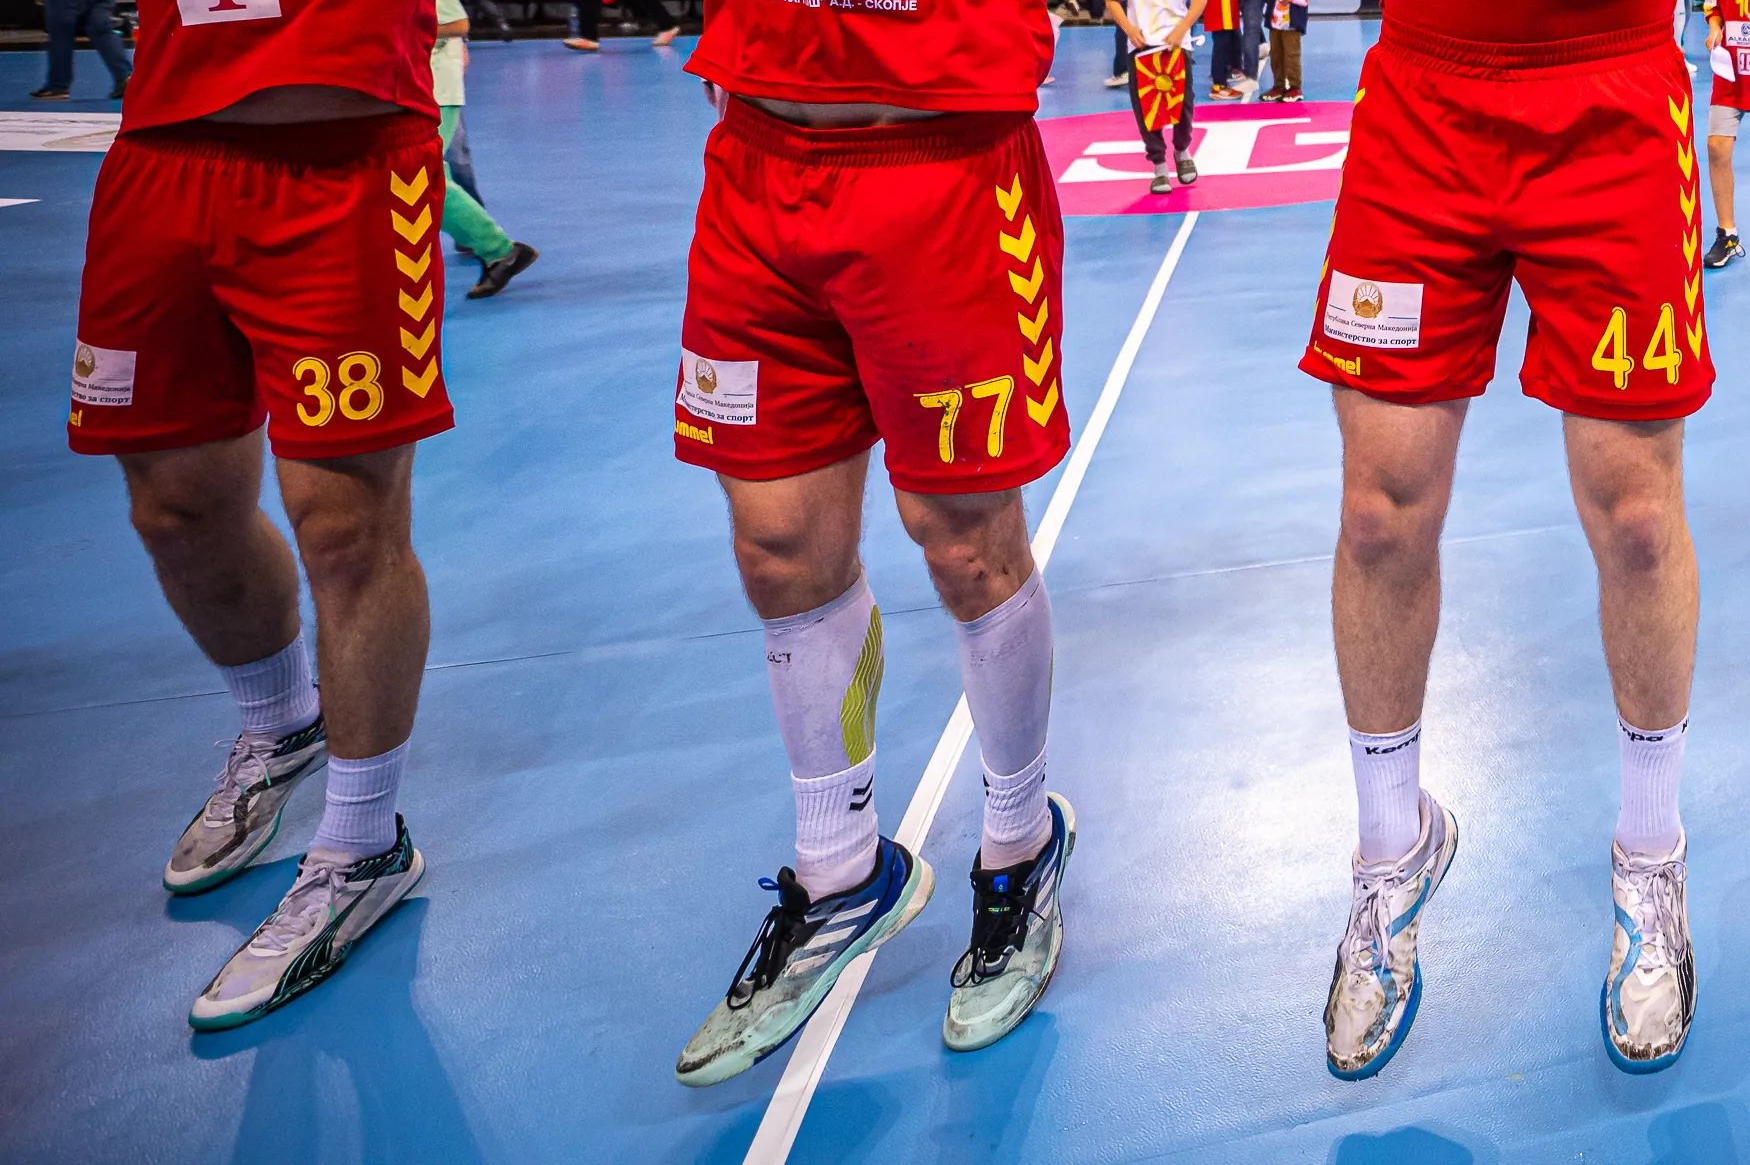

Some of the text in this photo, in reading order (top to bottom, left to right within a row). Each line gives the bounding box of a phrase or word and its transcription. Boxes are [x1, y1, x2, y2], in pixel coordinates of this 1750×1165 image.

[1390, 338, 1417, 346] спорт
[1591, 302, 1682, 390] 44
[100, 397, 130, 405] спорт
[292, 351, 384, 427] 38
[726, 415, 754, 423] спорт
[913, 375, 1014, 464] 77
